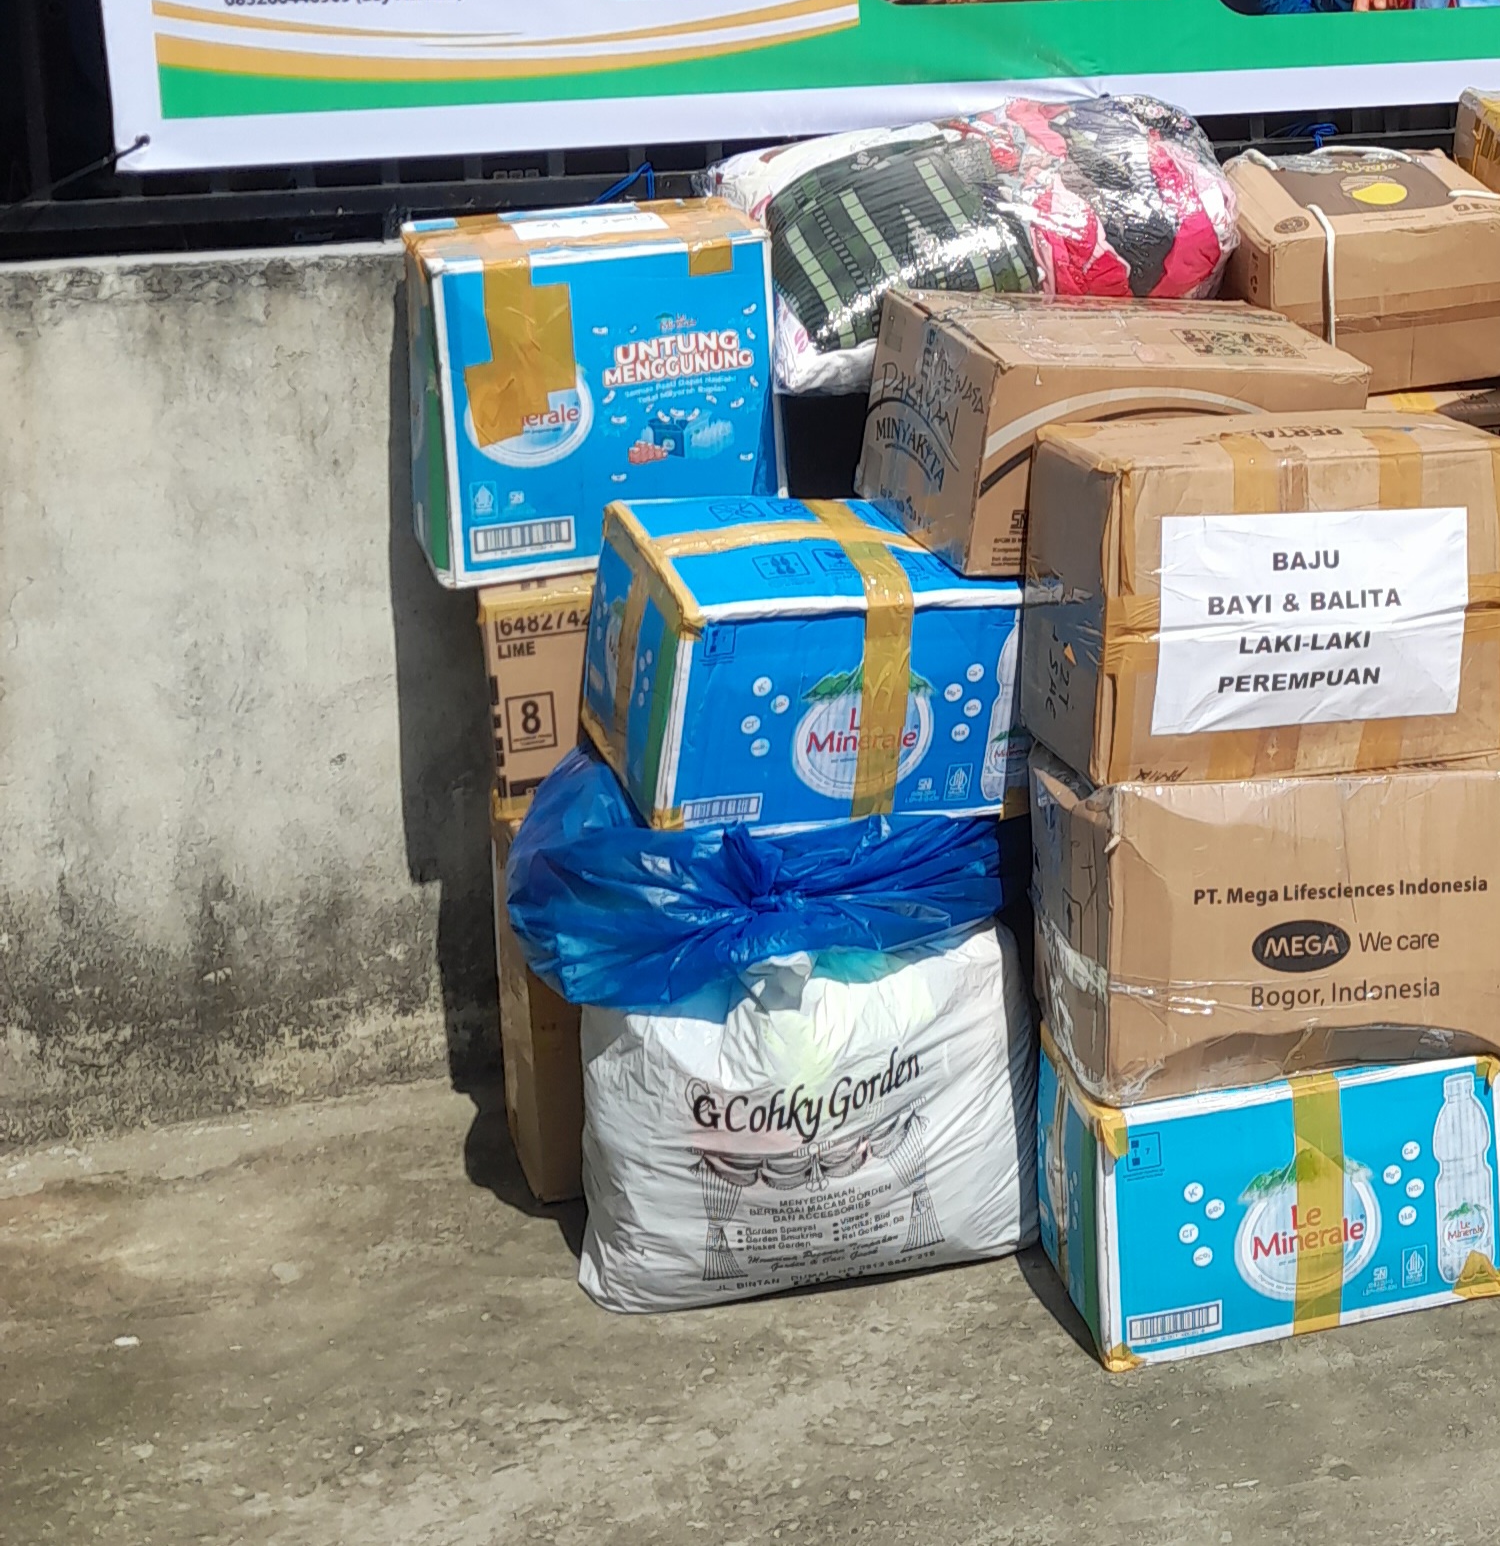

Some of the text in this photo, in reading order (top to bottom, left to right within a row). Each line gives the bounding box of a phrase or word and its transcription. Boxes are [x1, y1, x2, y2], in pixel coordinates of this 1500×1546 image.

[614, 330, 740, 365] UNTUNG
[603, 349, 754, 387] MENGGUNUNG
[1271, 549, 1340, 572] BAJU
[1207, 587, 1402, 617] BAYI & BALITA
[497, 640, 537, 660] LIME
[1238, 630, 1371, 655] LAKI-LAKI
[1216, 666, 1381, 694] PEREMPUAN
[521, 700, 541, 735] 8
[1193, 875, 1488, 906] PT. Mega Lifesciences Indonesia
[1263, 931, 1440, 959] MEGA We care
[1250, 976, 1440, 1010] Bogor, Indonesia
[1290, 1204, 1322, 1231] Le
[1252, 1218, 1365, 1261] Minerale
